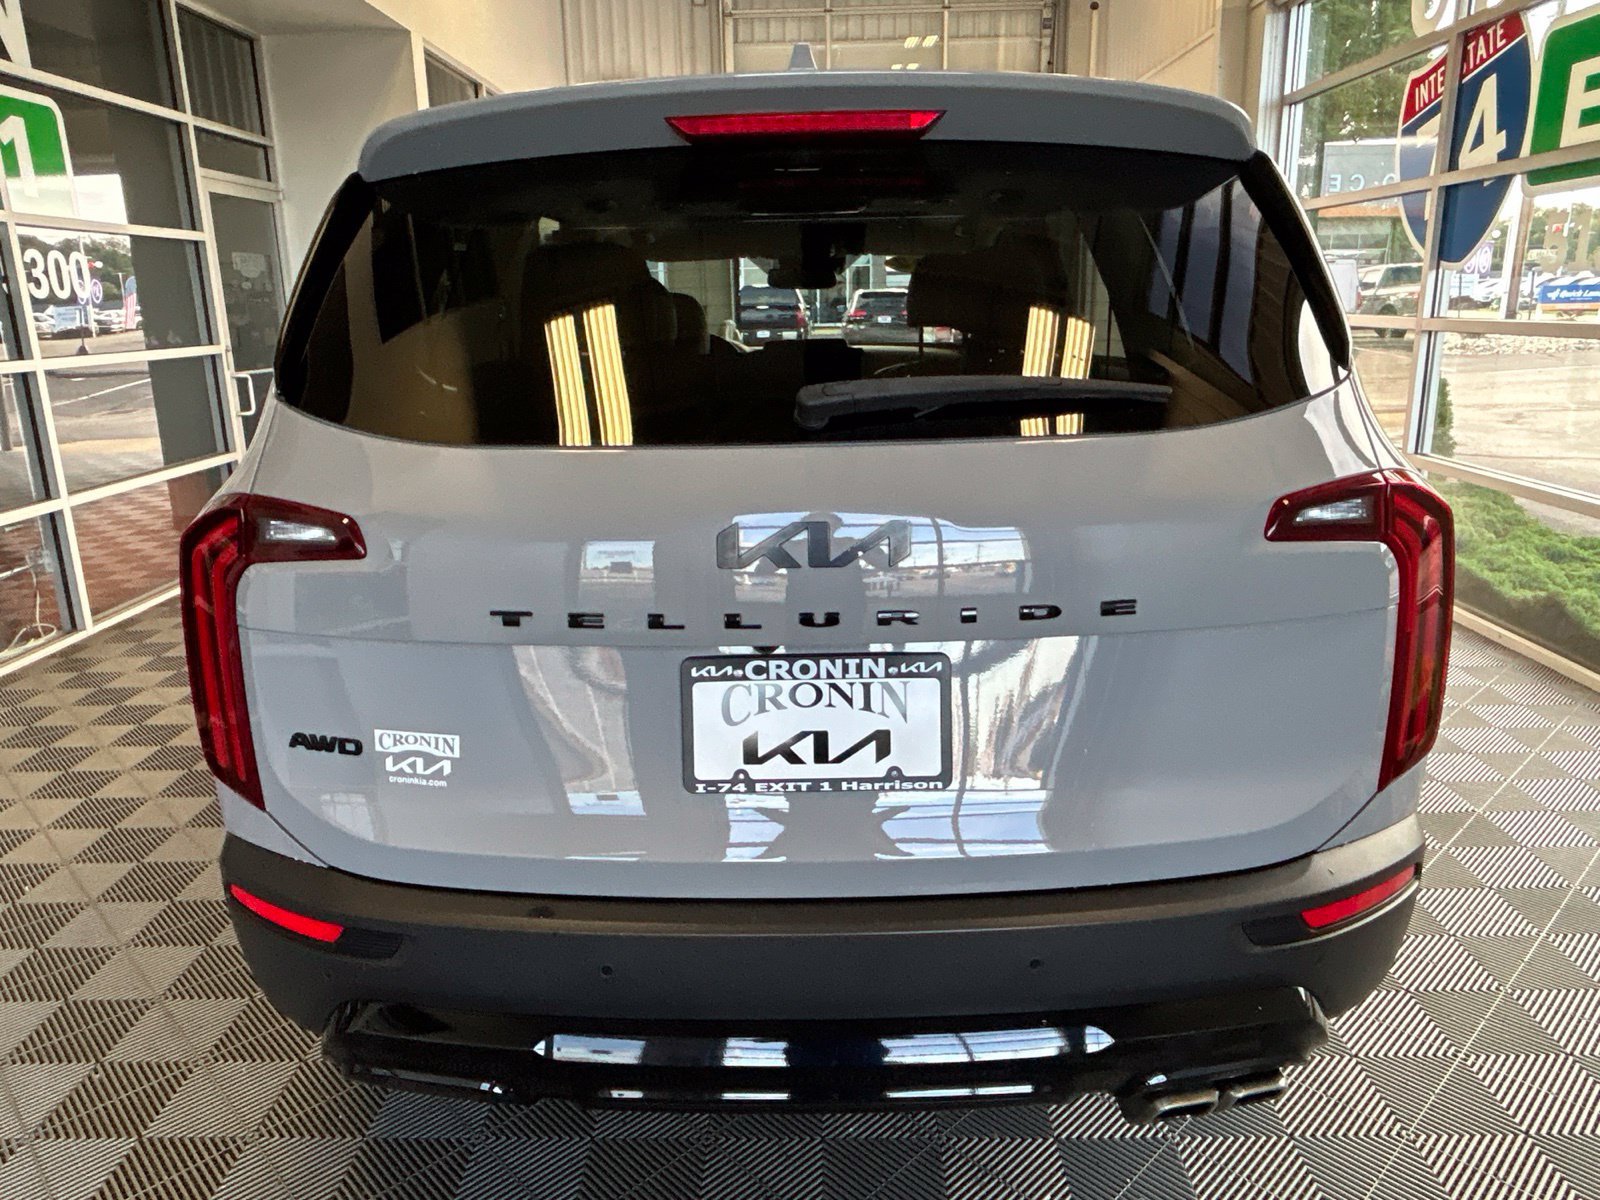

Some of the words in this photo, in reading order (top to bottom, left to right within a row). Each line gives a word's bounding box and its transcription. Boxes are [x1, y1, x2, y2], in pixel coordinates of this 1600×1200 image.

[1414, 18, 1508, 112] INTETATE
[716, 519, 912, 569] KIA
[489, 599, 1139, 630] TELLURIDE
[691, 664, 733, 677] KIA
[744, 658, 886, 680] CRONIN
[900, 661, 943, 674] KIA
[721, 681, 911, 726] CRONIN
[288, 731, 364, 757] AWD
[377, 731, 456, 756] CRONIN
[742, 729, 892, 765] KIA
[385, 755, 452, 777] KIA
[388, 775, 448, 788] croninkia.com
[695, 782, 747, 793] I-74
[755, 781, 812, 792] EXIT
[819, 780, 833, 791] 1
[841, 779, 944, 792] Harrison
